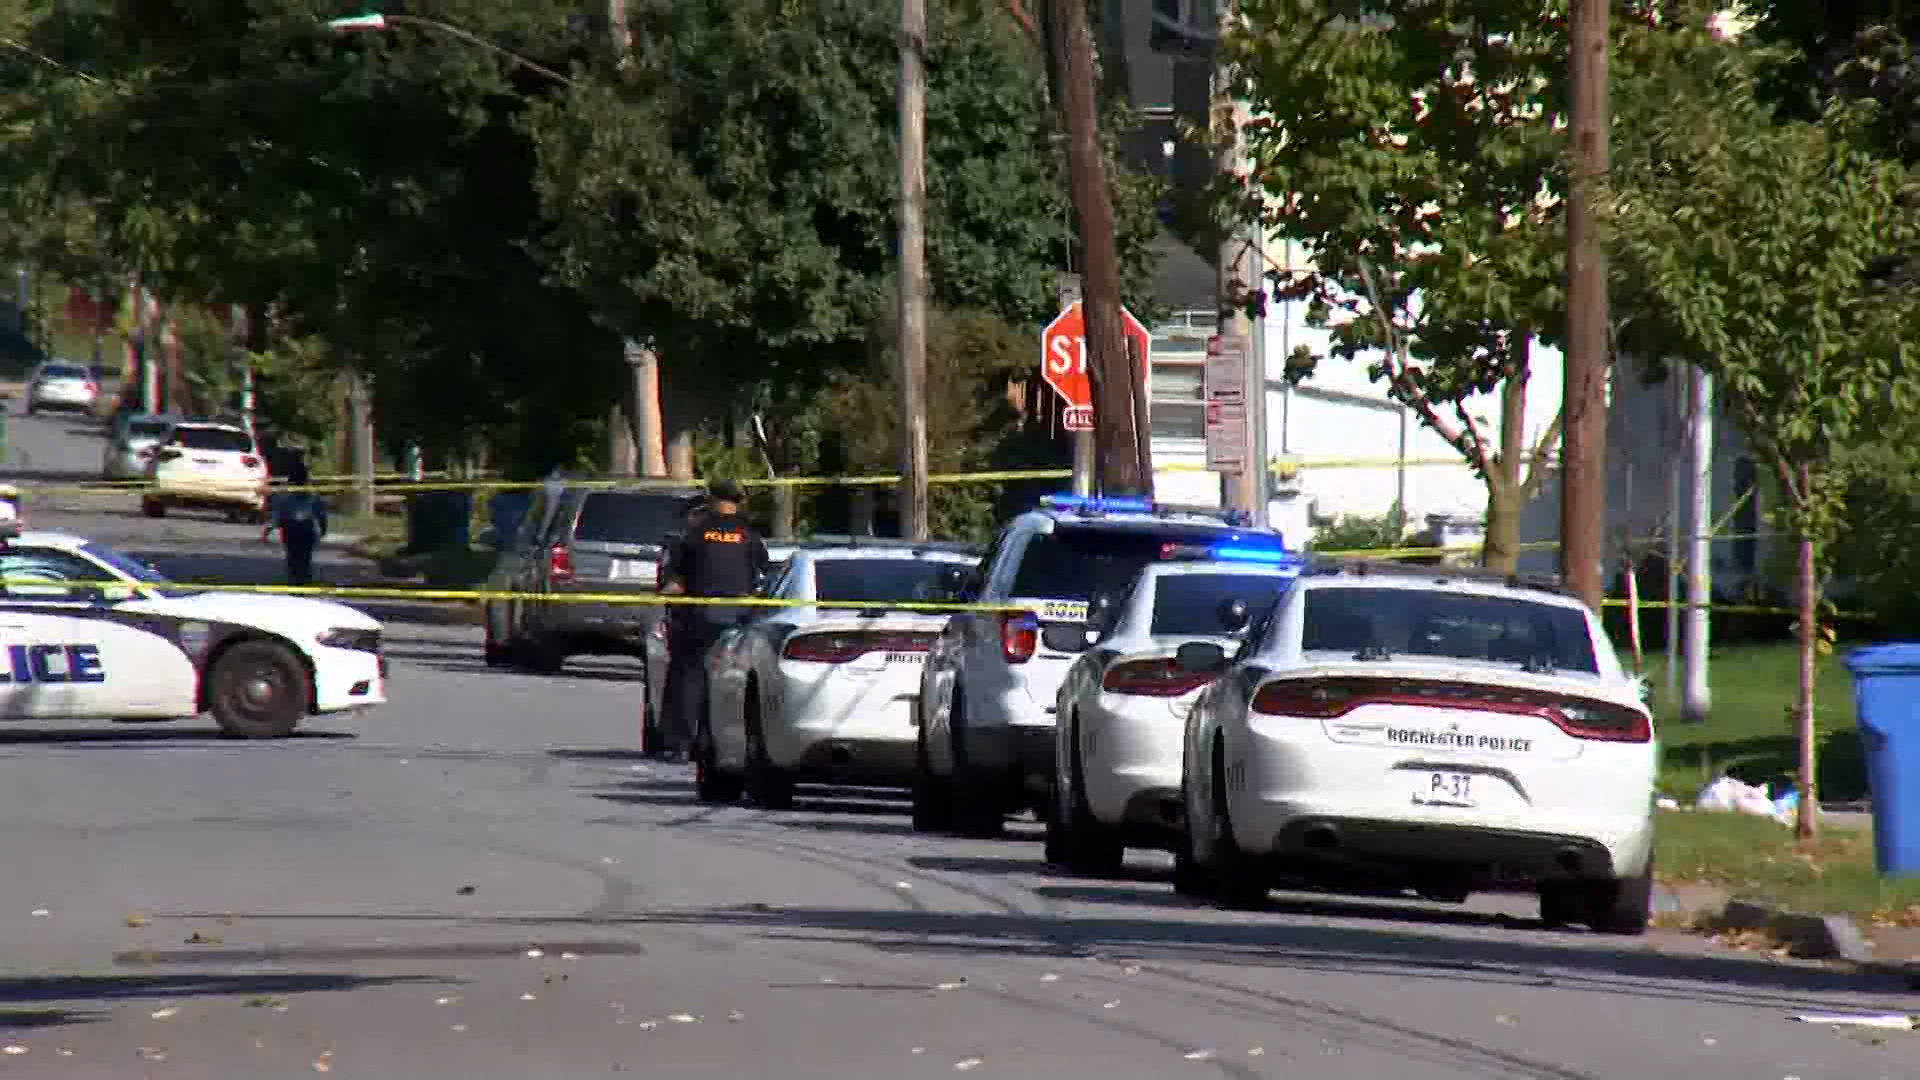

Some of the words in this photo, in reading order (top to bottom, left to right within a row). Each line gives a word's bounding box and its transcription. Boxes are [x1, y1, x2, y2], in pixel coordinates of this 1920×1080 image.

[704, 530, 746, 544] POLICE
[1387, 727, 1474, 746] ROCHESTER
[1479, 736, 1532, 752] POLICE
[1431, 772, 1472, 797] P-37
